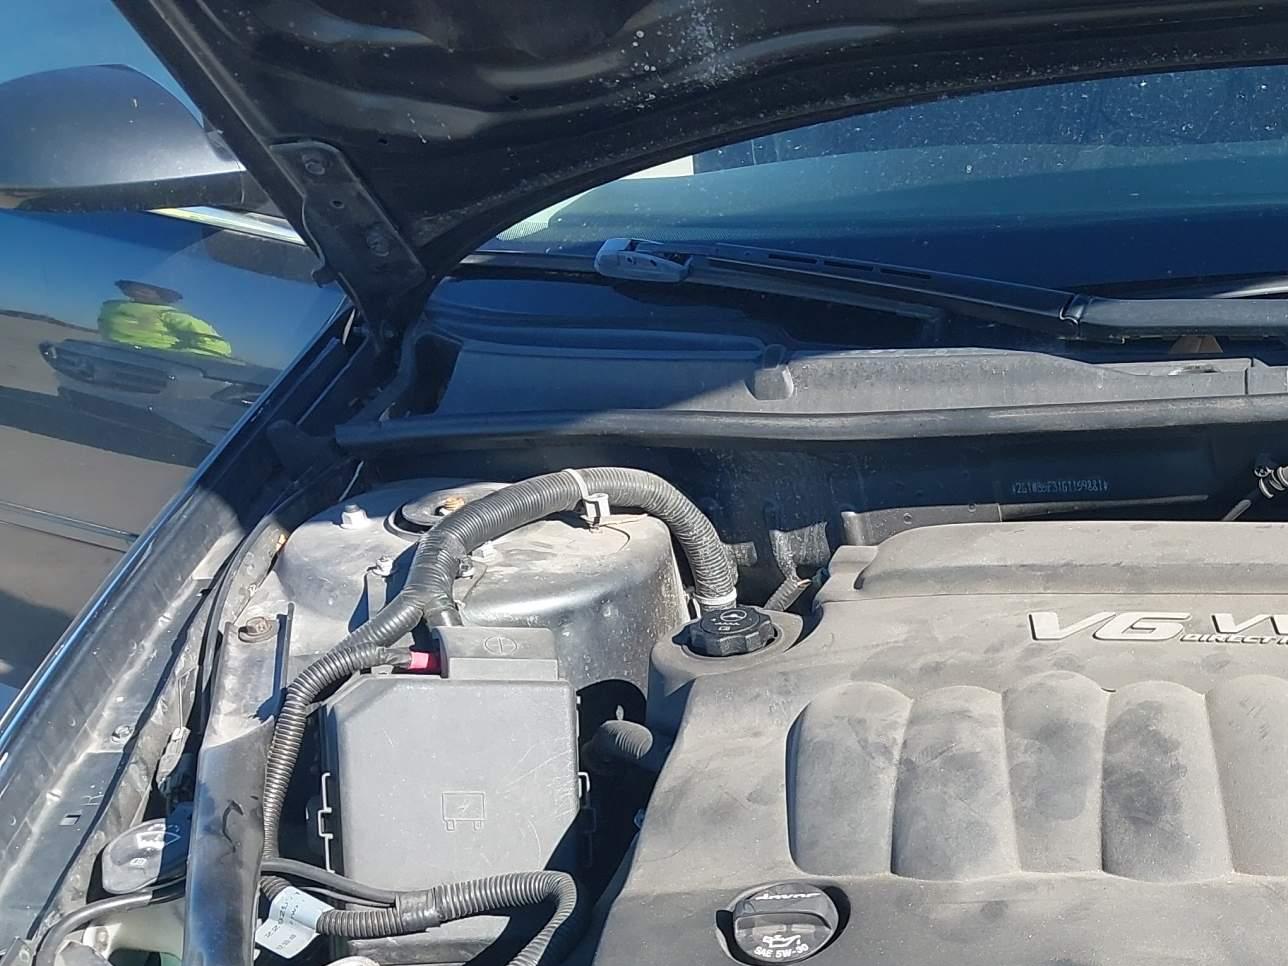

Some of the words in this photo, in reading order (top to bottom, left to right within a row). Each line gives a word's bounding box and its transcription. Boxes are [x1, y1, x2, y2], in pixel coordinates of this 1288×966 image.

[1027, 610, 1192, 642] V6
[1180, 633, 1278, 646] DIRECT
[754, 945, 774, 959] SAE
[775, 943, 810, 959] 5W-30
